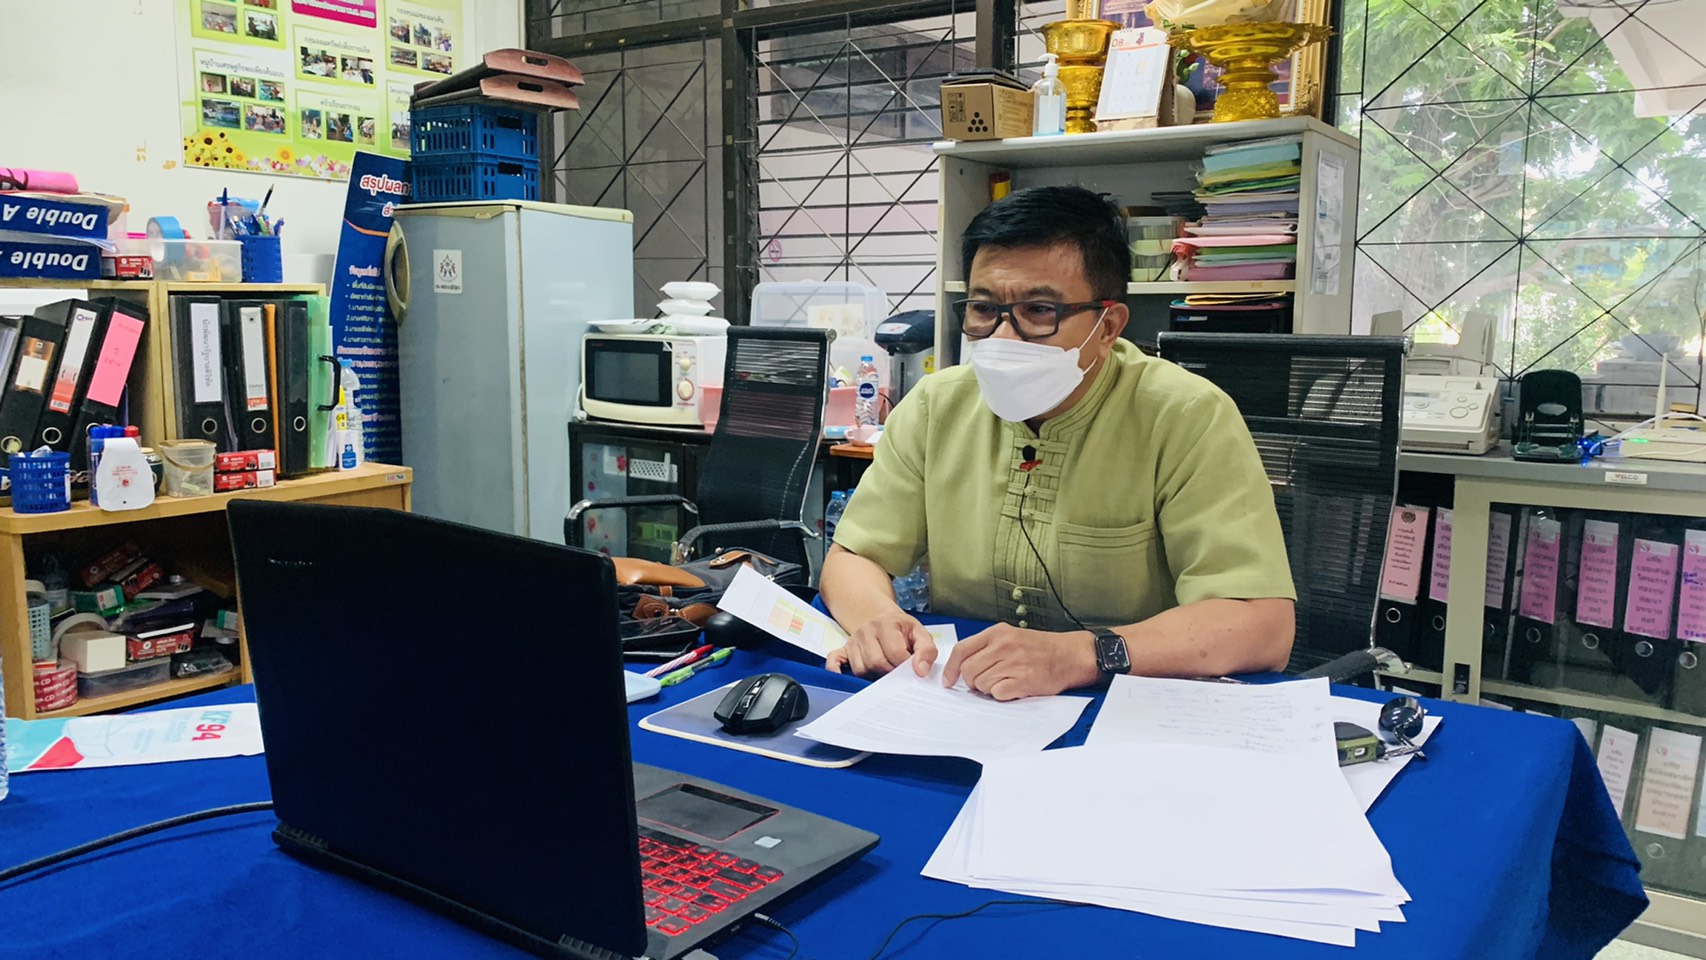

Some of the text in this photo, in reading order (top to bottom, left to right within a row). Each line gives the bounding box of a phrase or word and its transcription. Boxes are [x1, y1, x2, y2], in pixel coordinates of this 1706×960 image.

[2, 203, 98, 231] Double A
[10, 250, 89, 272] Double
[192, 710, 232, 742] KF94
